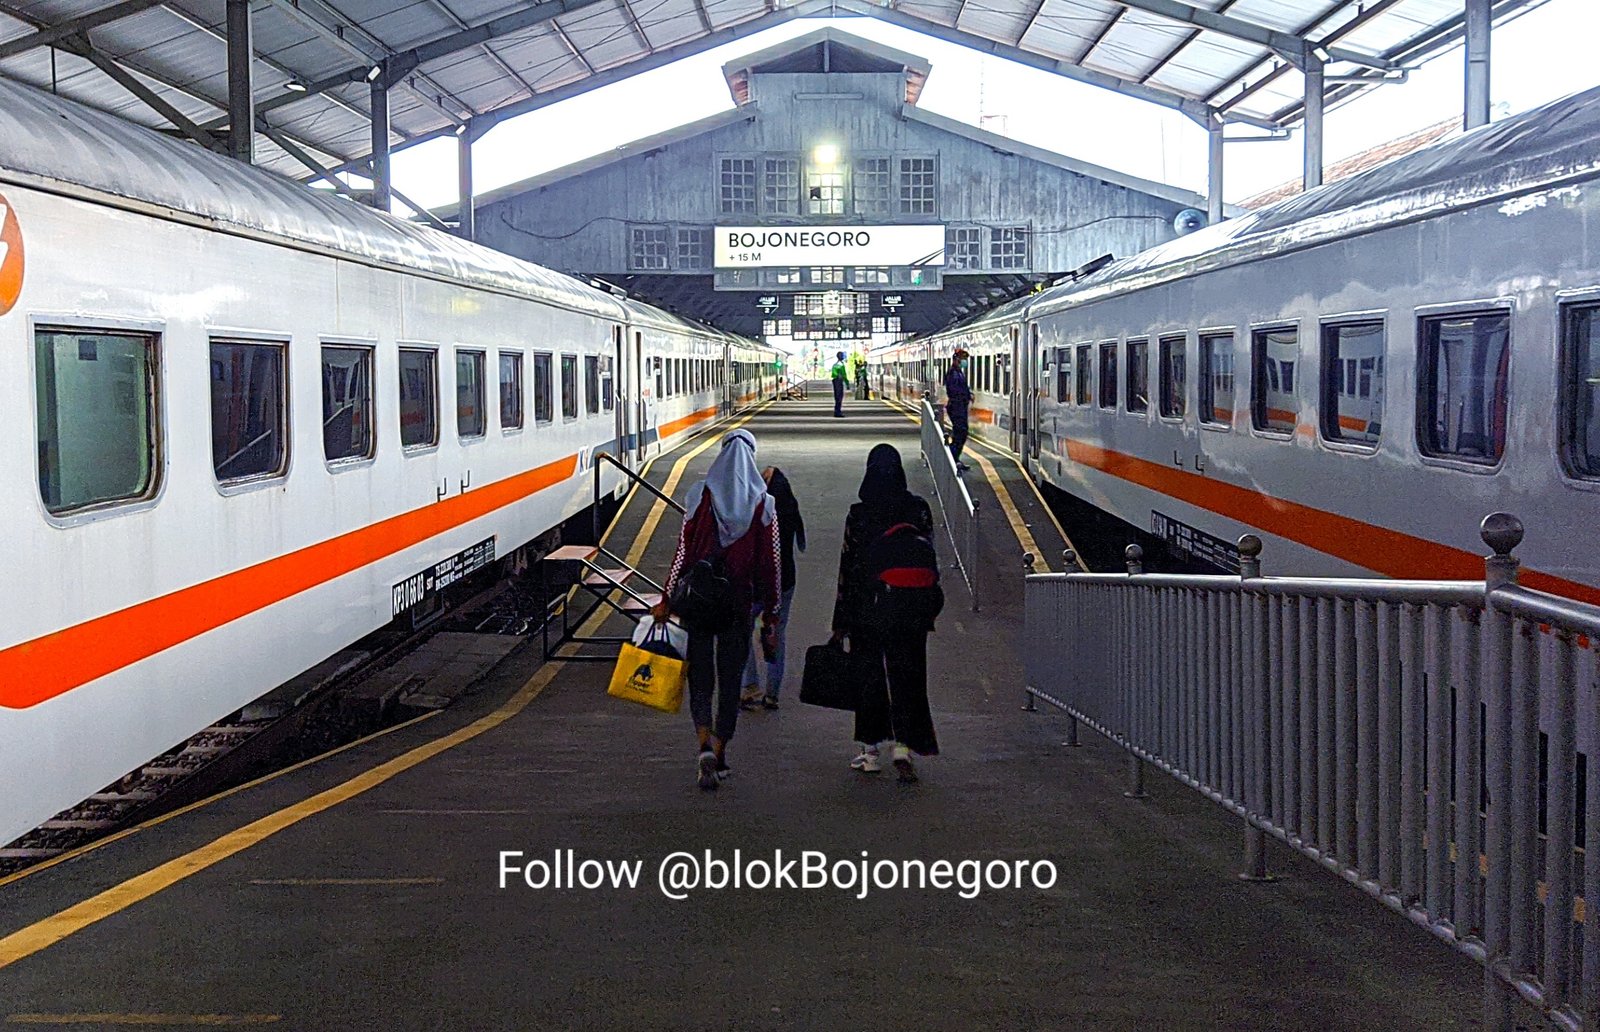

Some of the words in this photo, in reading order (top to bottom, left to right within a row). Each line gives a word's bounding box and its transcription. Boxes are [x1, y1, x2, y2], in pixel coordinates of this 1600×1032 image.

[729, 232, 870, 248] BOJONEGORO
[738, 253, 749, 261] 15
[752, 253, 761, 261] M
